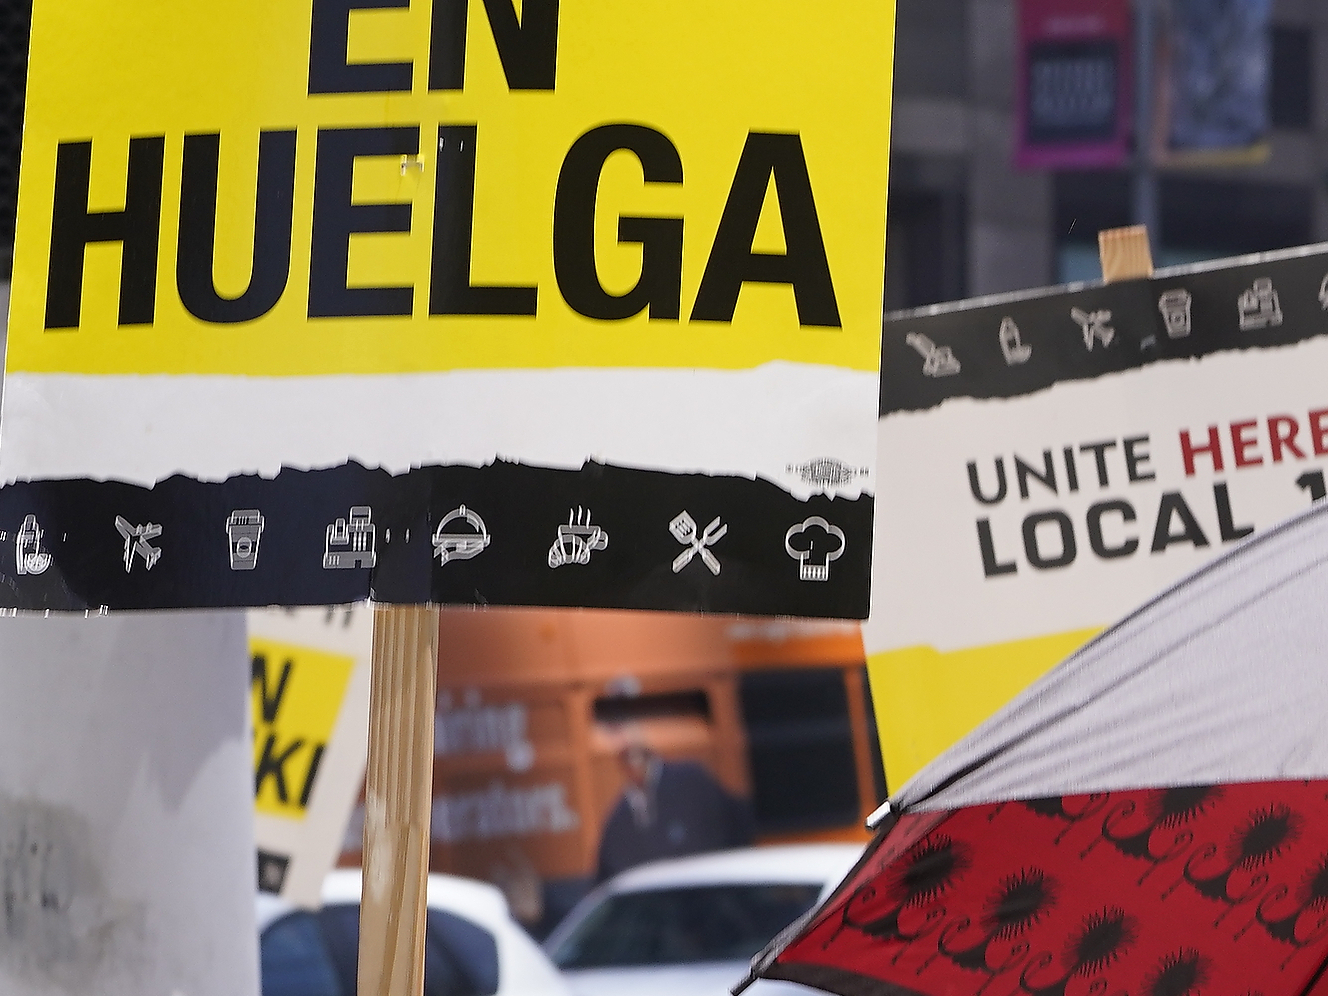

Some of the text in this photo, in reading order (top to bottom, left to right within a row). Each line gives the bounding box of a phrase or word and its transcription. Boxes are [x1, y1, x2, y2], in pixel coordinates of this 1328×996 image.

[307, 0, 559, 96] EN
[45, 122, 842, 330] HUELGA
[966, 432, 1157, 507] UNITE
[975, 480, 1256, 580] LOCAL
